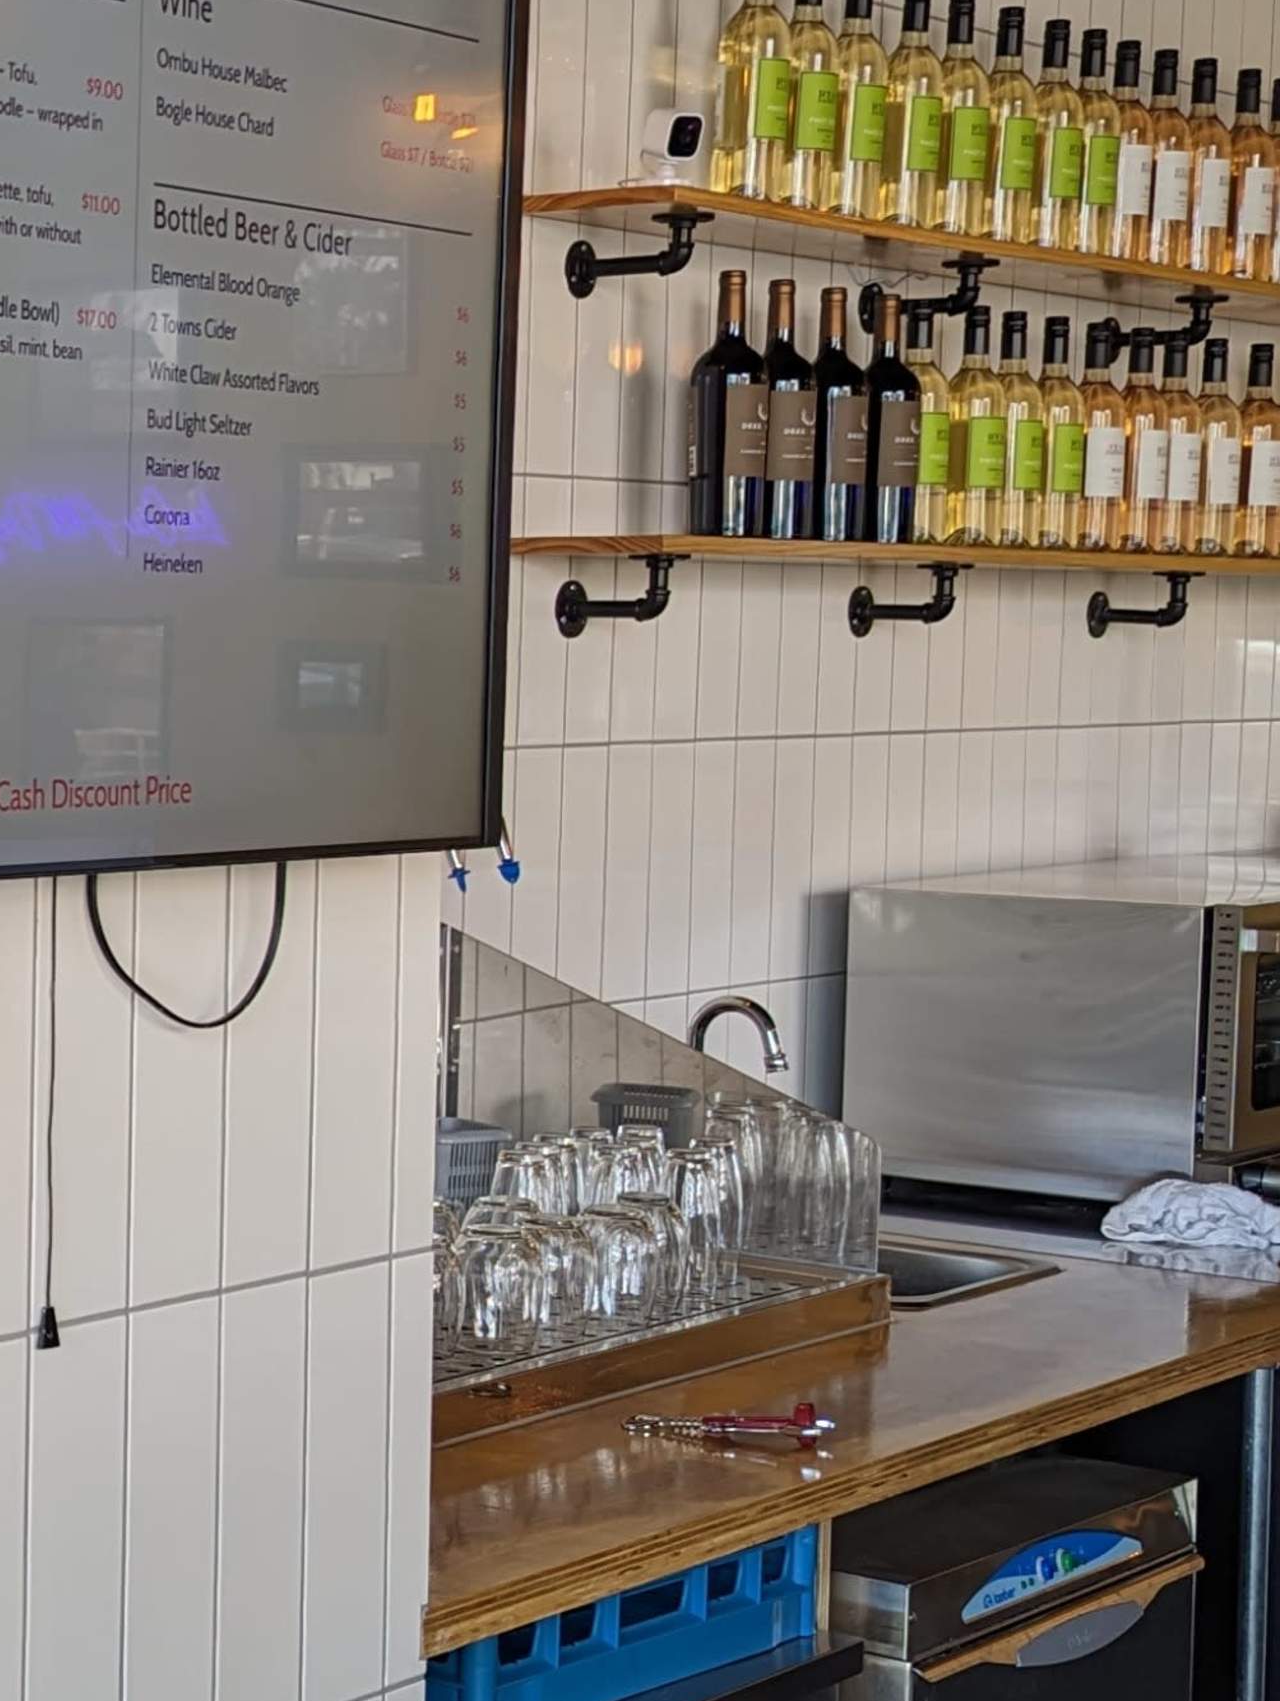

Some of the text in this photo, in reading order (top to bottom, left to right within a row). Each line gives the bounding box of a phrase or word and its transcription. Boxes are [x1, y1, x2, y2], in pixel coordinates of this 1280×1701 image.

[200, 55, 242, 84] House
[242, 64, 288, 94] Malbec
[155, 95, 275, 138] Bogle House Chard
[153, 197, 354, 257] Bottled Beer & Cider
[150, 262, 301, 306] Elemental Blood Orange
[19, 298, 60, 327] Bowl)
[75, 306, 121, 331] $17.00
[161, 312, 203, 338] Towns
[203, 316, 238, 341] Cider
[147, 359, 320, 396] White Claw Assorted Flavors
[146, 407, 253, 439] Bud Light Seltzer
[144, 455, 221, 482] Rainier 16oz
[143, 503, 191, 527] Corona
[142, 551, 204, 574] Heineken
[50, 778, 142, 809] Discount
[144, 774, 192, 805] Price
